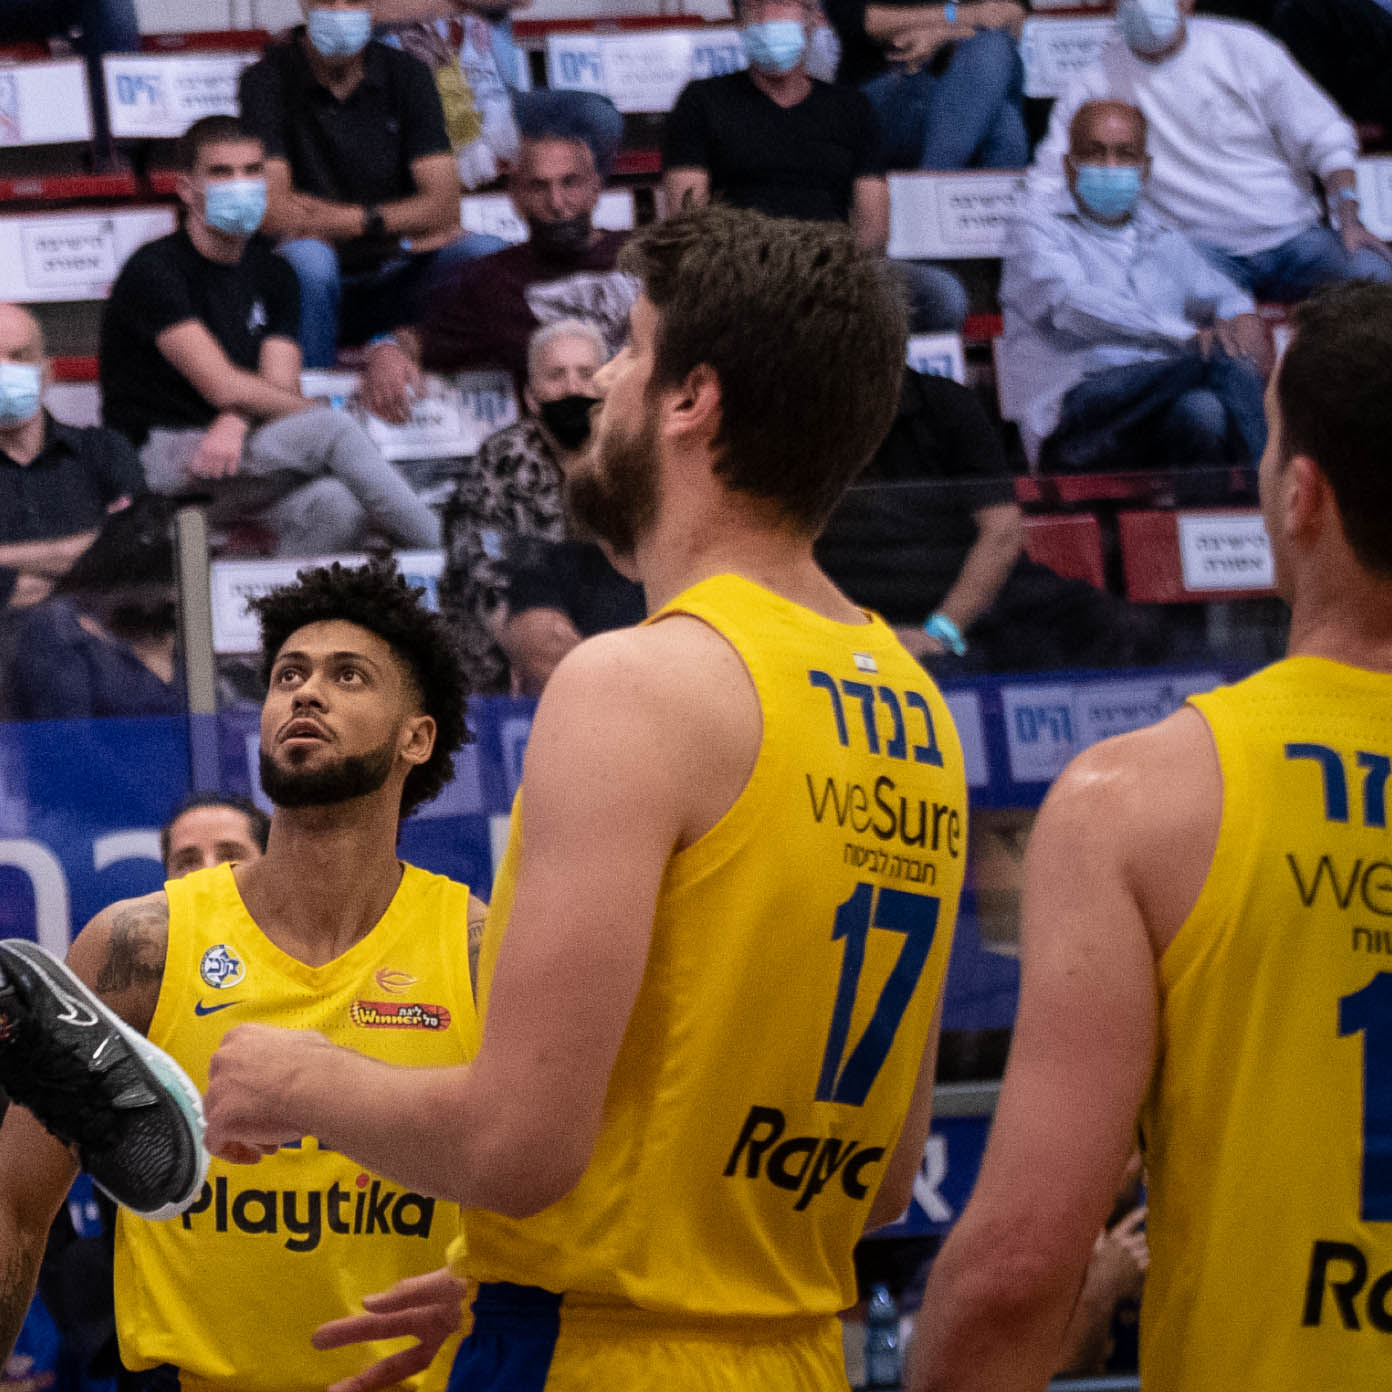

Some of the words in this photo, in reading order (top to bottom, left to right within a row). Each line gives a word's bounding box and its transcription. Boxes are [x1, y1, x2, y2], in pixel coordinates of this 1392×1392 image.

[804, 668, 944, 770] בנדר
[804, 772, 962, 860] weSure
[359, 1008, 422, 1027] Winner
[813, 881, 943, 1108] 17
